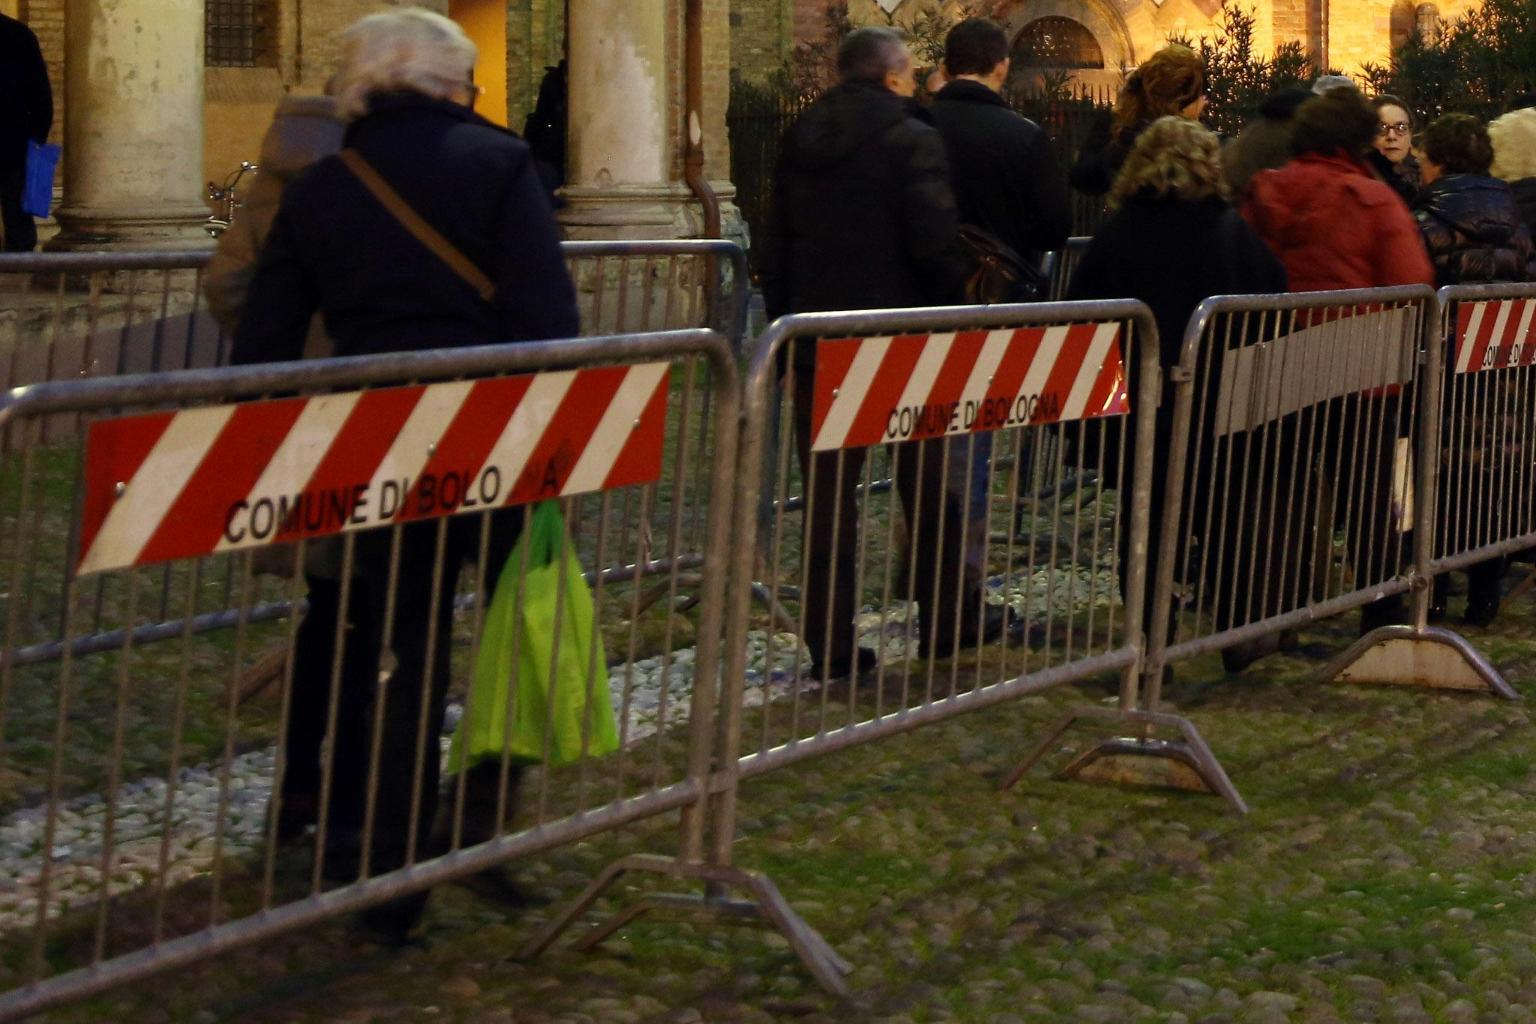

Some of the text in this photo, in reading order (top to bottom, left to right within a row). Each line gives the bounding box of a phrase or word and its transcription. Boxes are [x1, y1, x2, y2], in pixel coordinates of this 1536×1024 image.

[887, 393, 1059, 438] COMUNE DI BOLOGNA
[224, 456, 558, 543] COMUNE DI BOLOA
